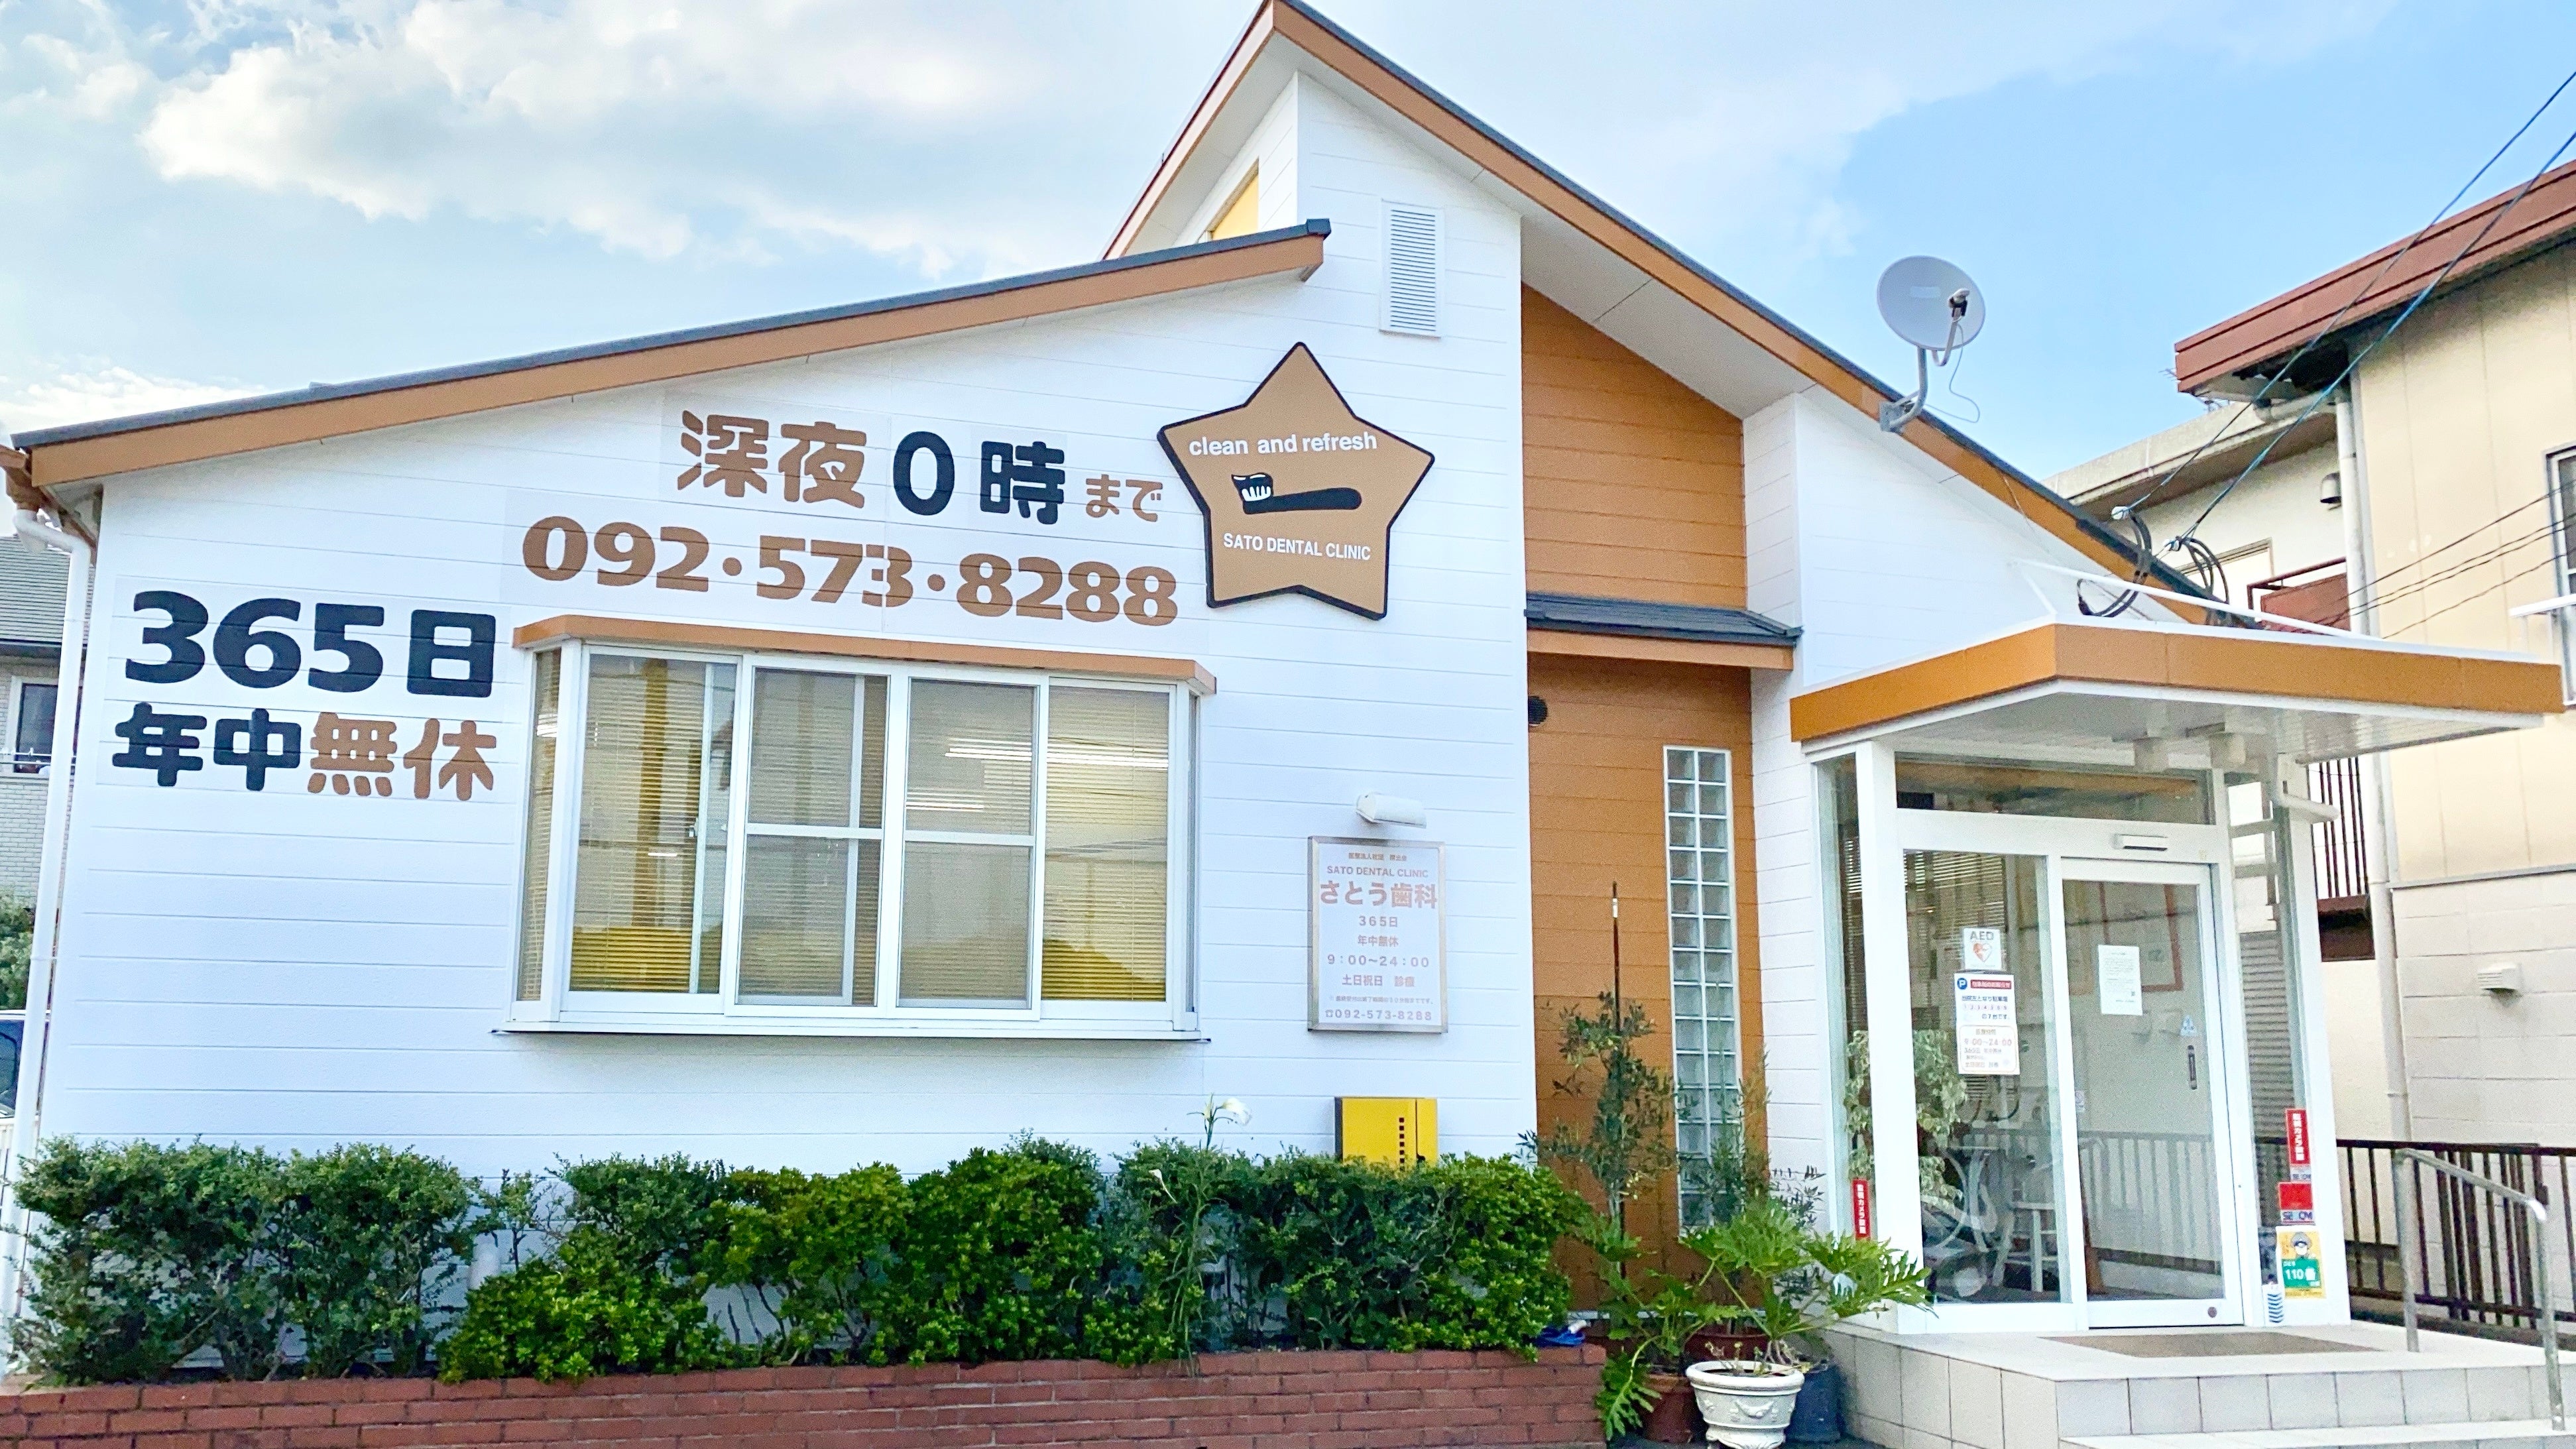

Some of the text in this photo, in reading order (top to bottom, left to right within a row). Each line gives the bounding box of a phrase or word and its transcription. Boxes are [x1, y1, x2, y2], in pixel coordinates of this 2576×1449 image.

[1189, 432, 1377, 455] clean and refresh
[1224, 533, 1371, 561] SATO DENTAL CLINIC
[125, 591, 497, 698] 365日
[112, 701, 496, 801] 年中無休
[1327, 866, 1429, 878] SATO DENTAL CLINIC
[1320, 880, 1437, 909] さとう歯科
[1359, 915, 1398, 927] 365日
[1358, 935, 1399, 947] 年中無休
[1970, 931, 1994, 940] AED
[1342, 974, 1383, 986] 土日祝日
[1335, 1010, 1432, 1020] 092-573-8288
